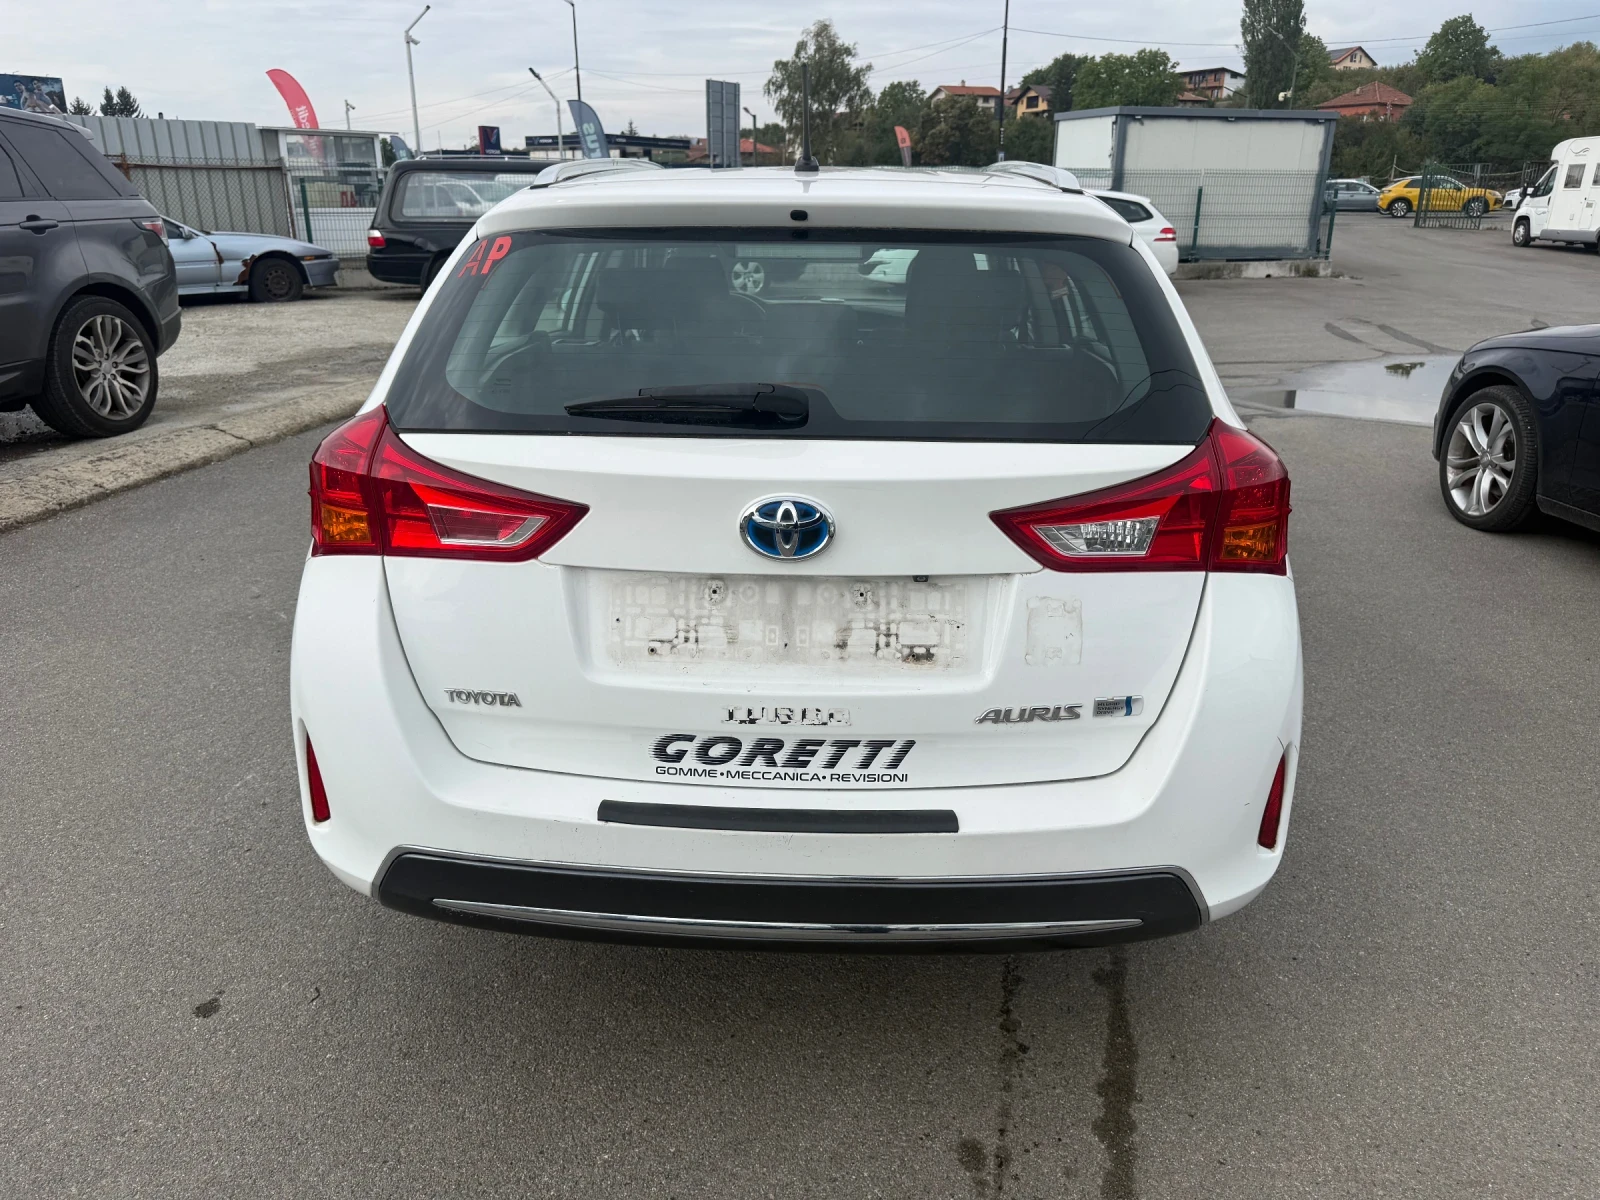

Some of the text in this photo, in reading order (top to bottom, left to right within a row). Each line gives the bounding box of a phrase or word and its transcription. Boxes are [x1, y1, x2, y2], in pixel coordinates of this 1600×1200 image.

[457, 235, 512, 278] AP
[443, 687, 522, 708] TOYOTA
[721, 705, 852, 726] TURBO
[974, 703, 1083, 725] AURIS
[648, 733, 917, 770] GORETTI
[830, 773, 908, 783] REVISIONI
